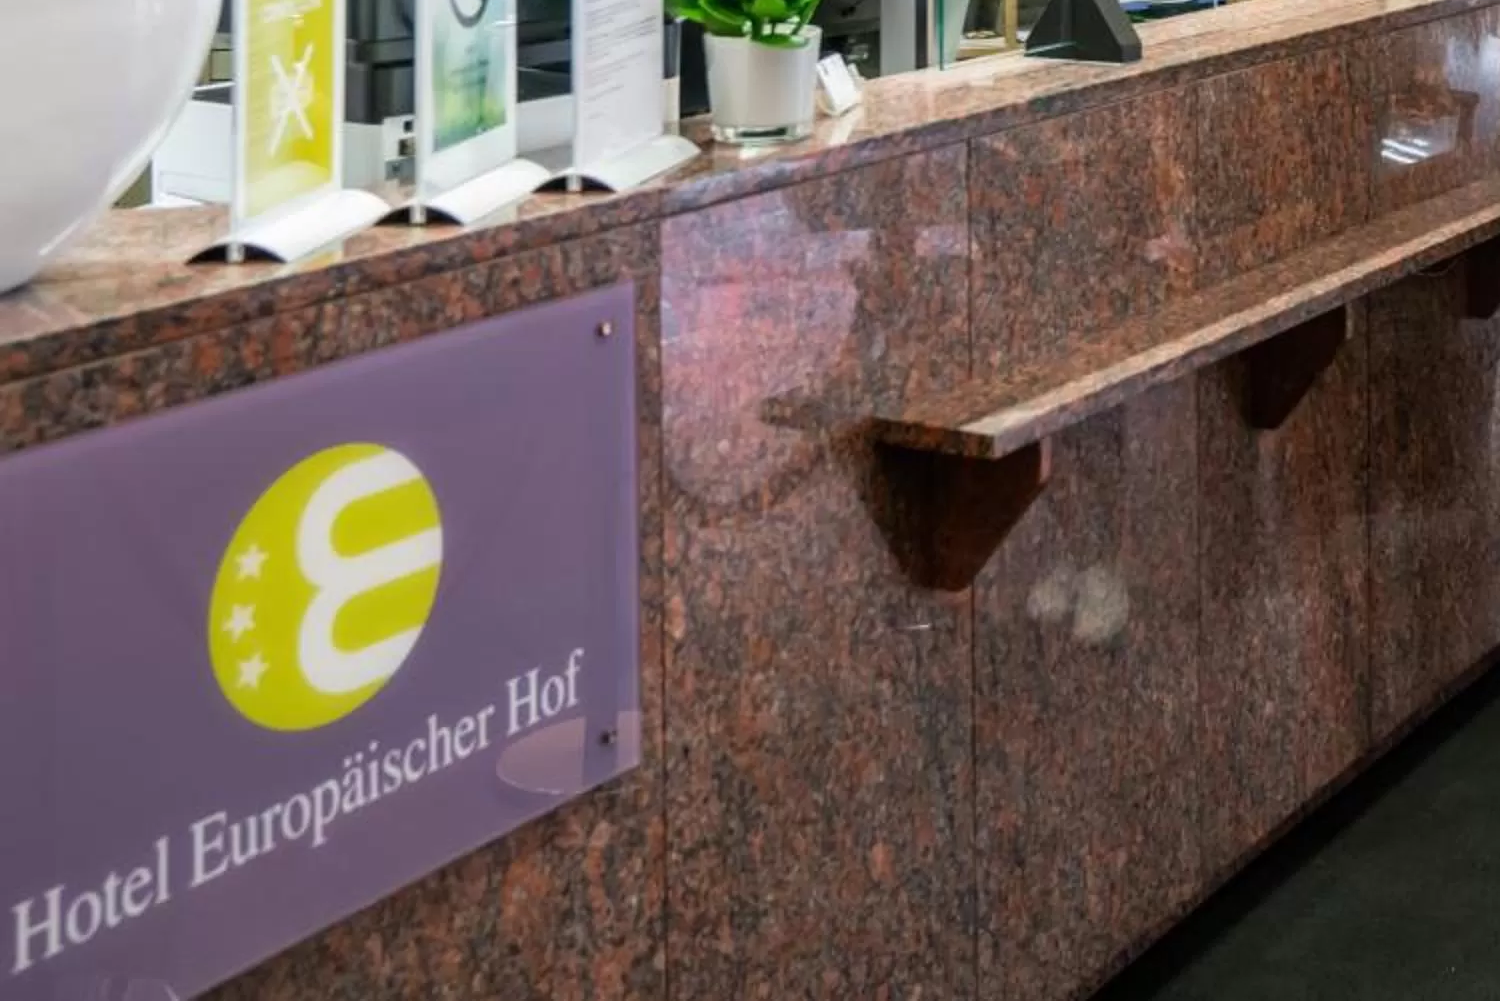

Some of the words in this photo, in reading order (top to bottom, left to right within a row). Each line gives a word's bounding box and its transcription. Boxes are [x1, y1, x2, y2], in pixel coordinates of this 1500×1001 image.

[11, 837, 171, 974] Hotel
[190, 704, 496, 887] Europäischer
[506, 648, 586, 737] Hof
